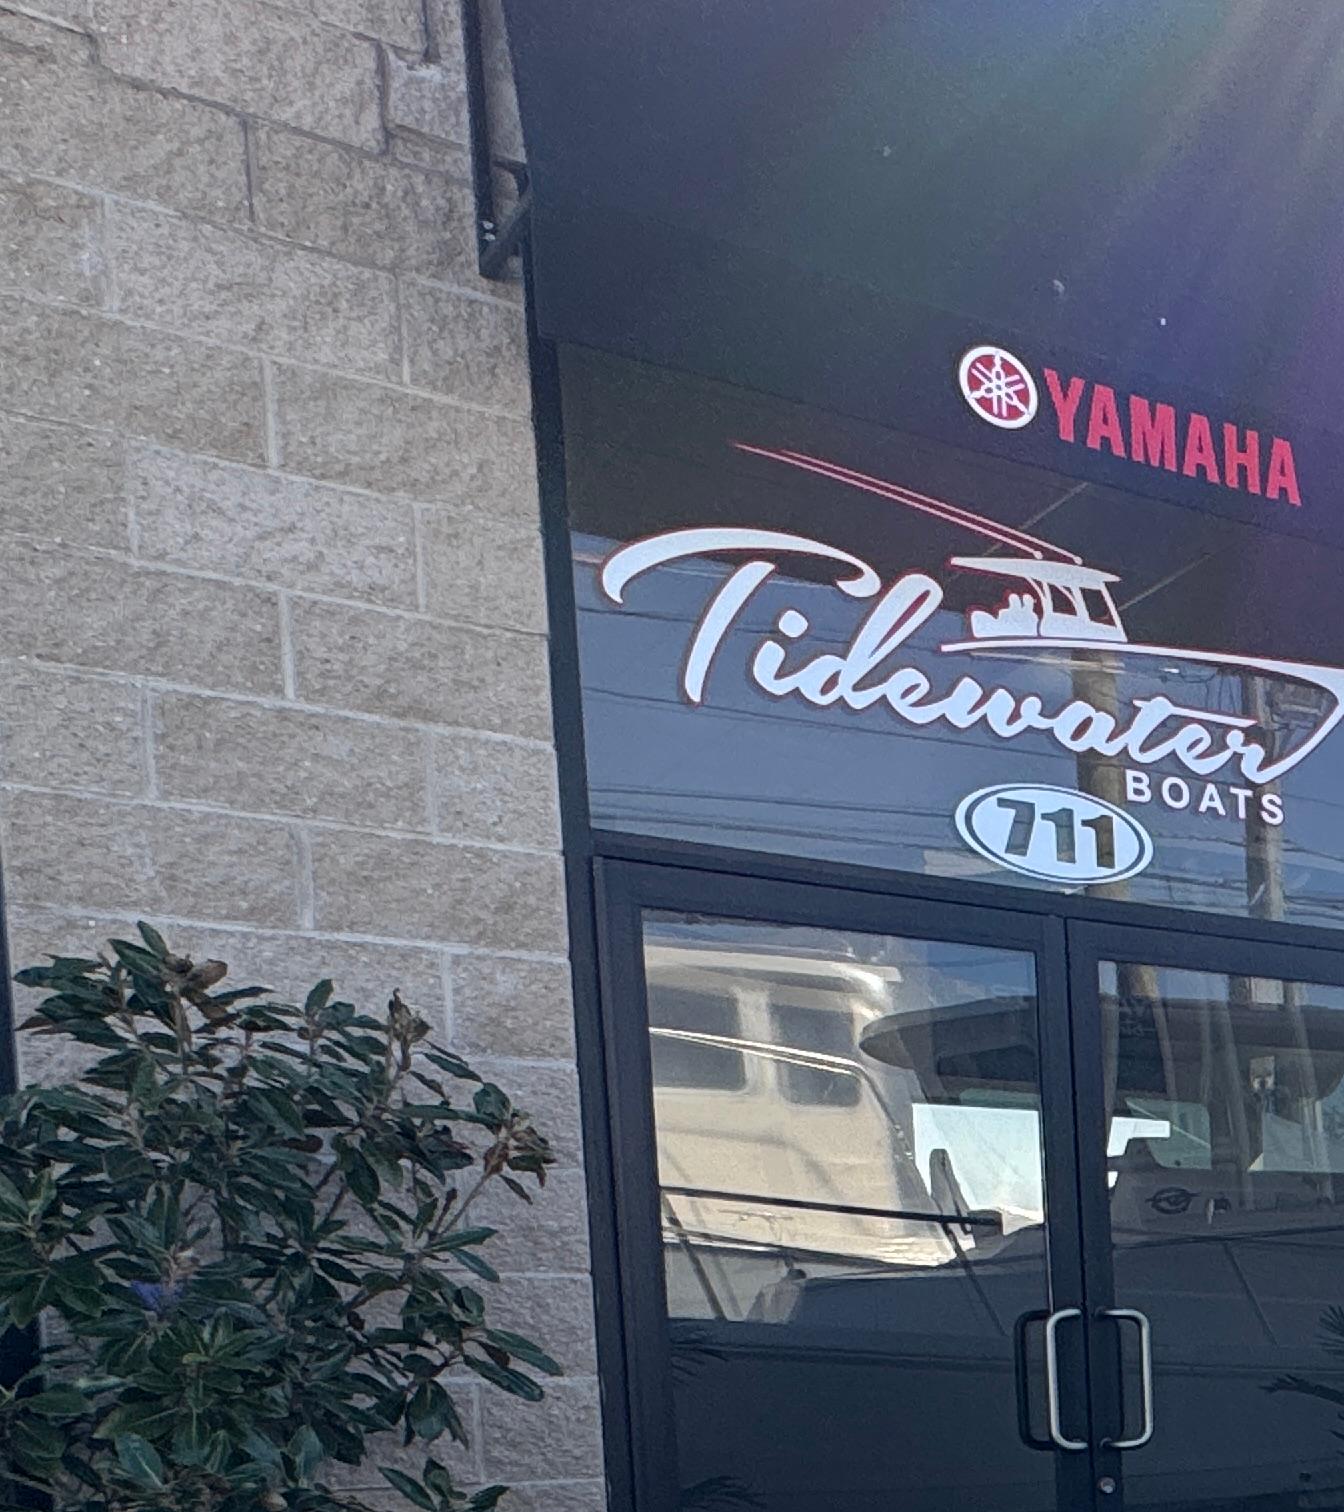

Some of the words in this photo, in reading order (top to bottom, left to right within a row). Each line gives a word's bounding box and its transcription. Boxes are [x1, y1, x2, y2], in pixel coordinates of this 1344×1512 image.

[1044, 368, 1303, 507] YAMAHA
[601, 526, 1290, 787] Tidewater
[996, 797, 1118, 873] 711
[1126, 768, 1285, 825] BOATS
